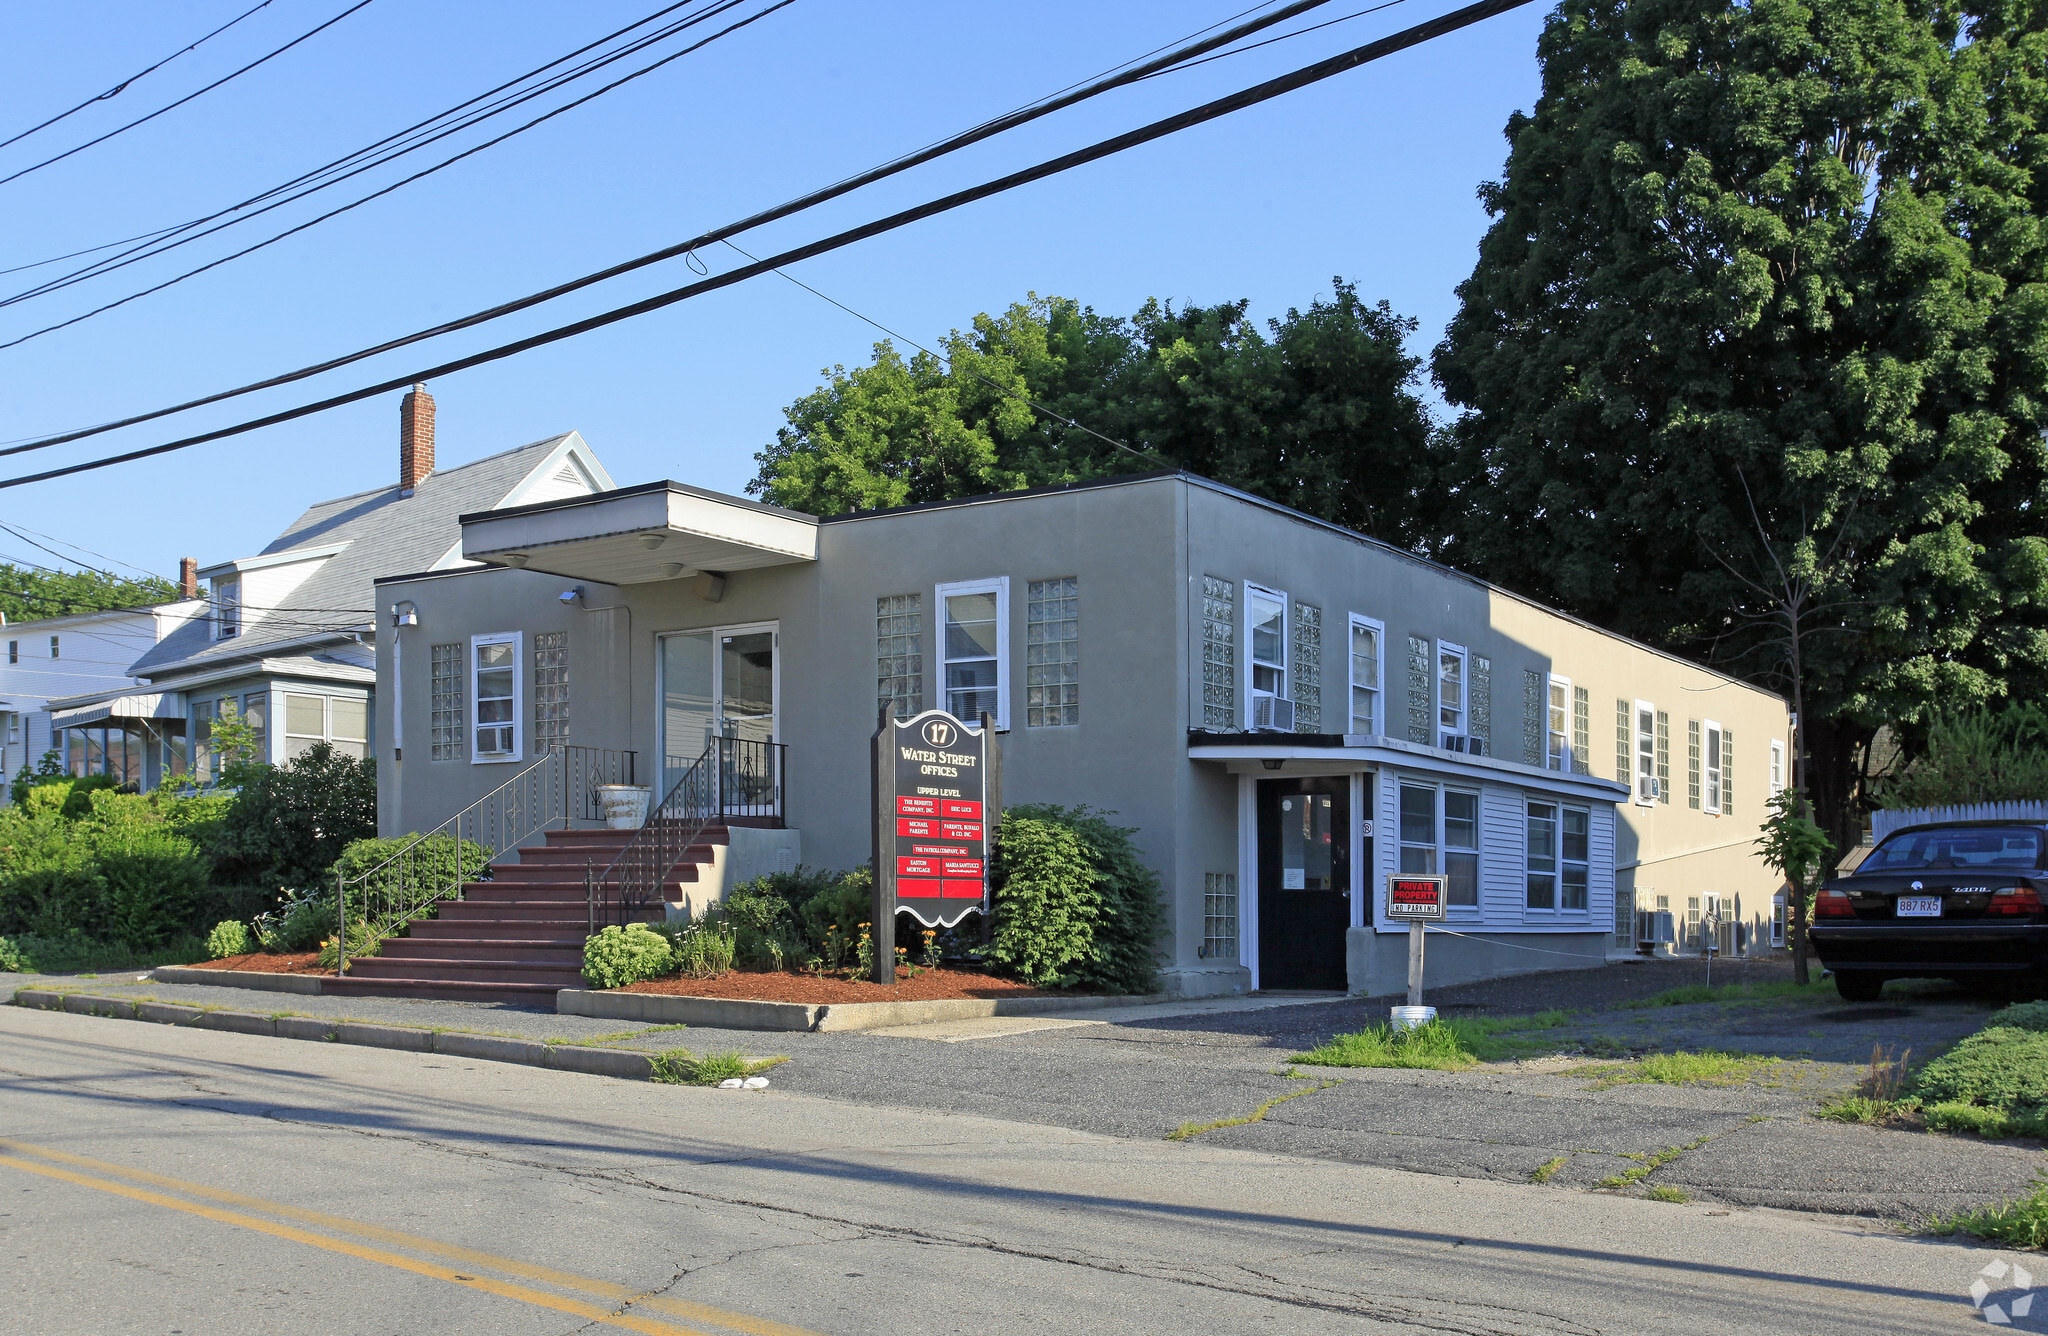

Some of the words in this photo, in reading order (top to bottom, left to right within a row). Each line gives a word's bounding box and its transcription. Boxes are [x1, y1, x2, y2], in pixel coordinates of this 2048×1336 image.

[931, 724, 948, 744] 17
[901, 746, 936, 762] WATER
[939, 751, 976, 766] STREET
[921, 765, 957, 777] OFFICES
[917, 787, 938, 795] UPPER
[1398, 882, 1434, 890] PRIVATE
[1394, 890, 1437, 899] PROPERTY
[1900, 901, 1918, 911] 887
[1920, 901, 1938, 911] RX5
